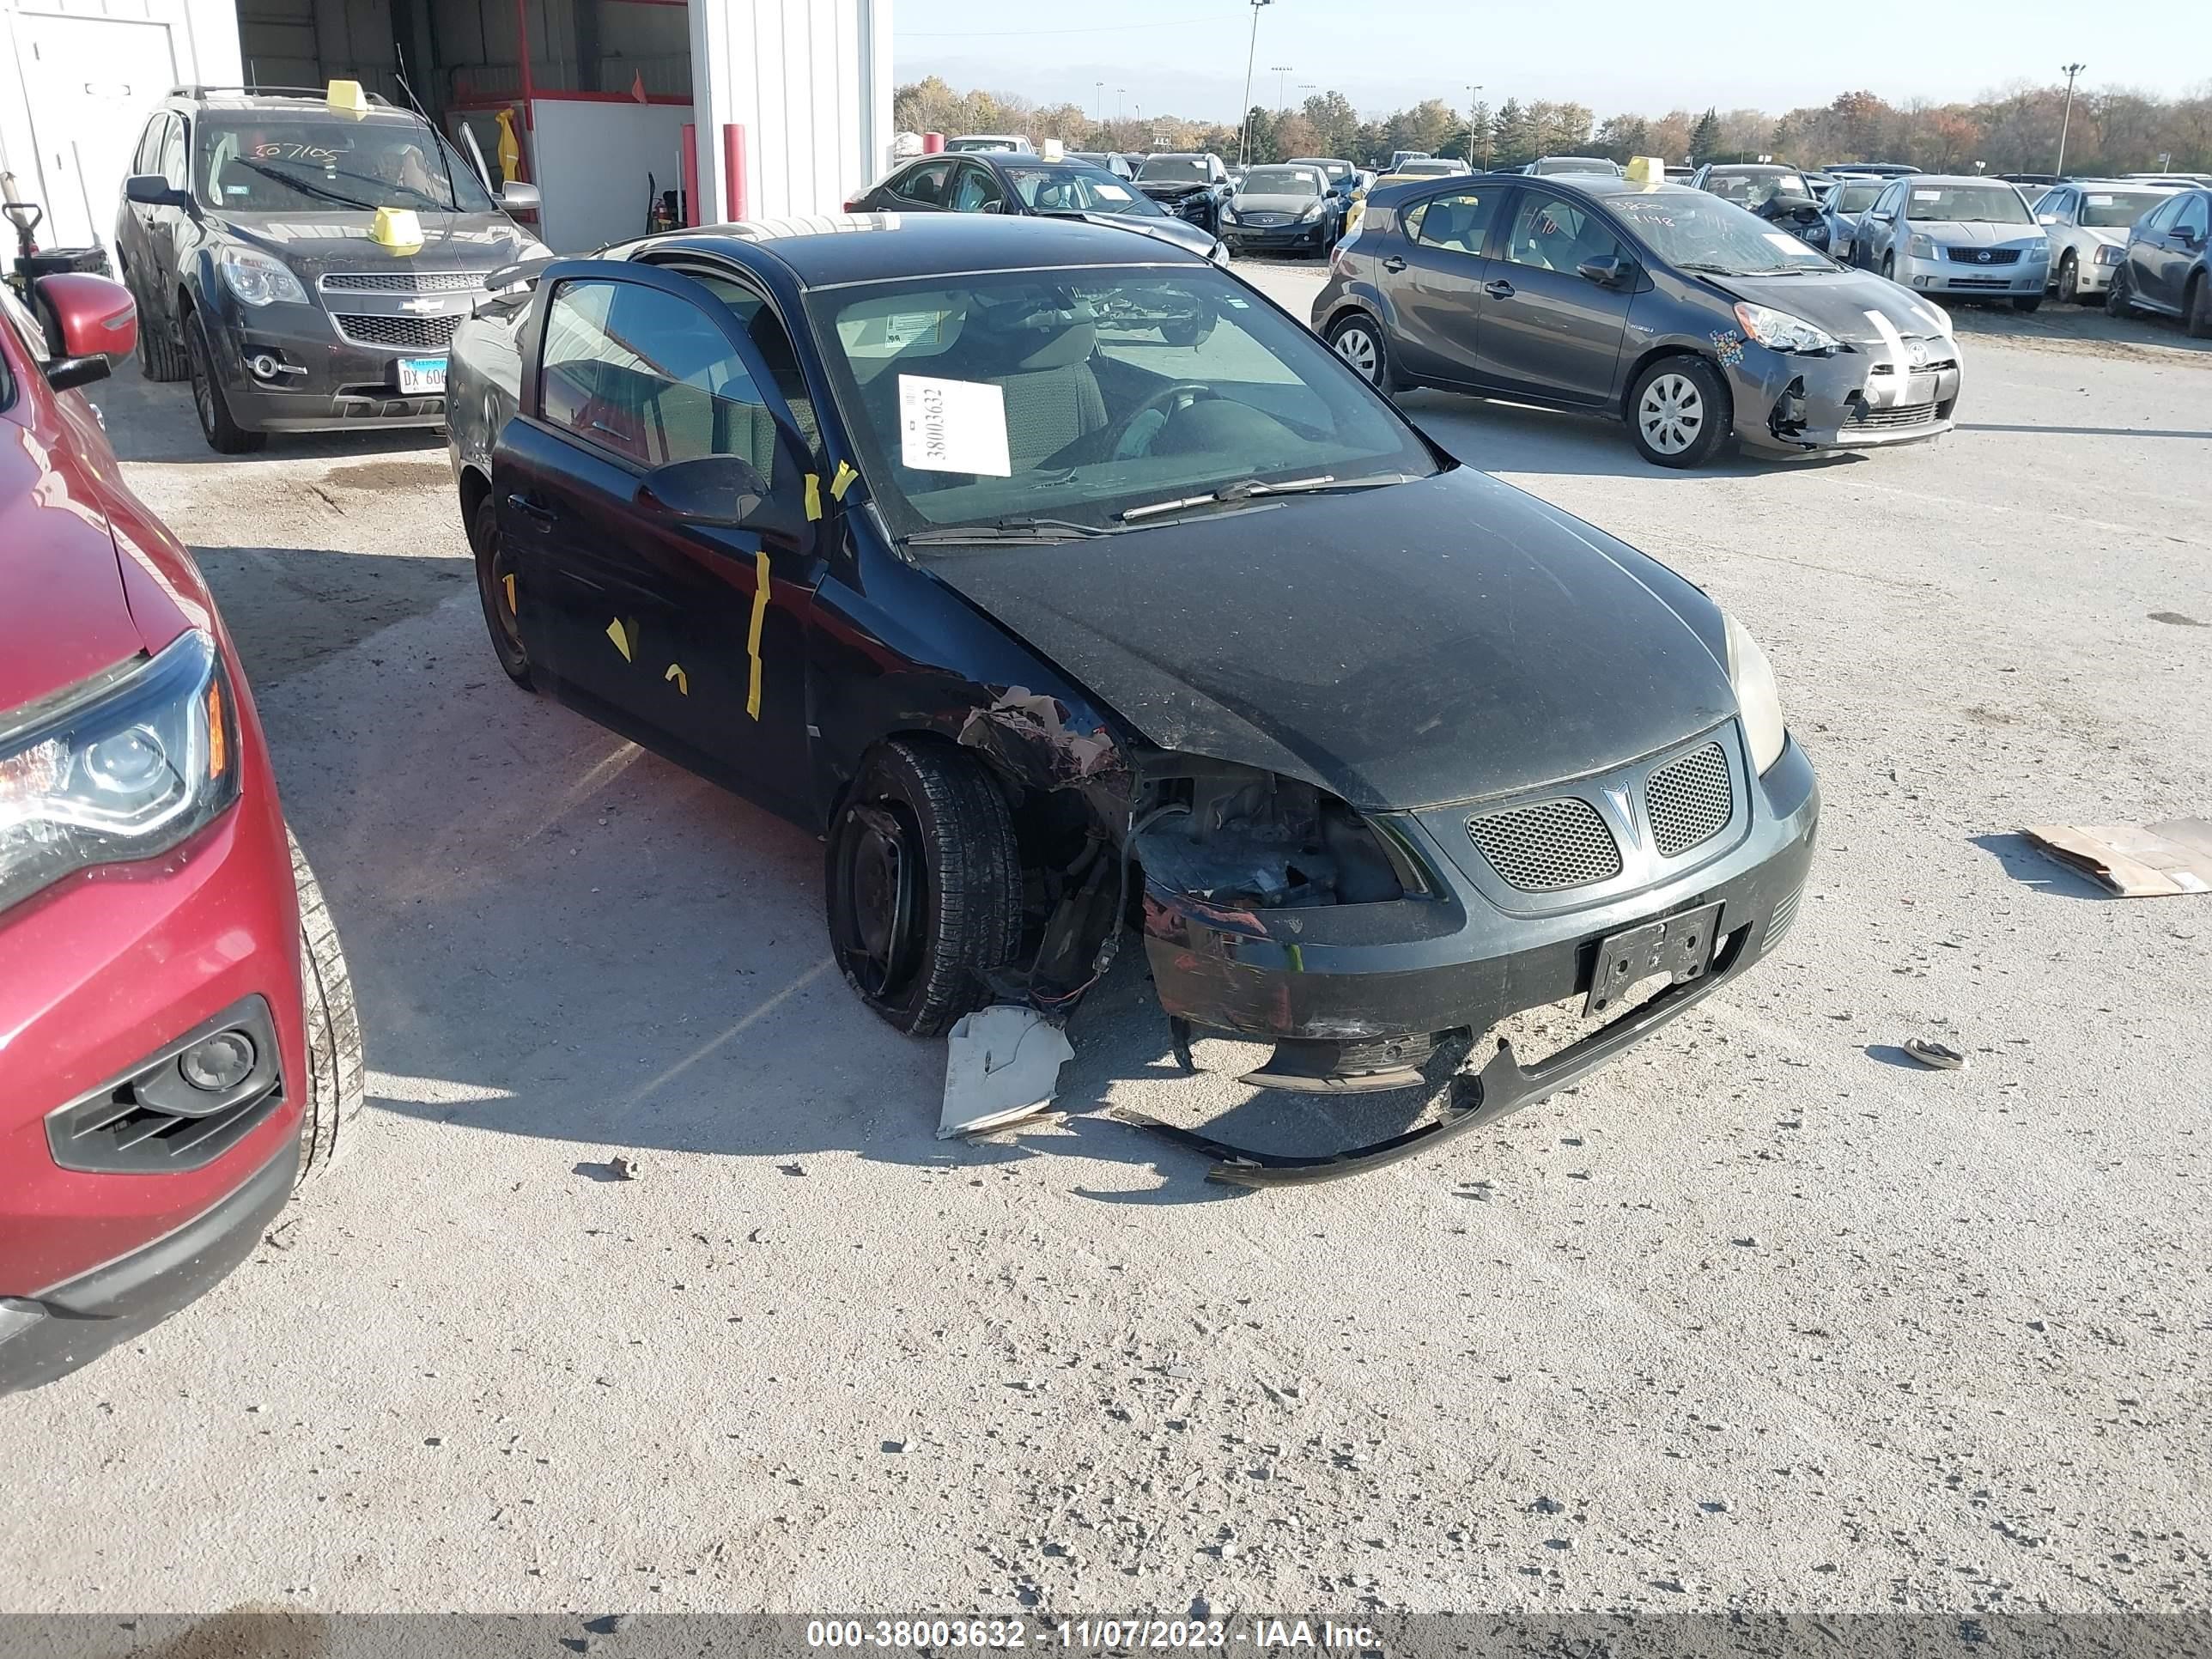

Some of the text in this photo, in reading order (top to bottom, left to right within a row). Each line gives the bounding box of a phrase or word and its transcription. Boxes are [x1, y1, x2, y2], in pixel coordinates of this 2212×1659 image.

[1626, 213, 1677, 228] 4148
[404, 369, 420, 386] DX
[923, 388, 946, 460] 38003632
